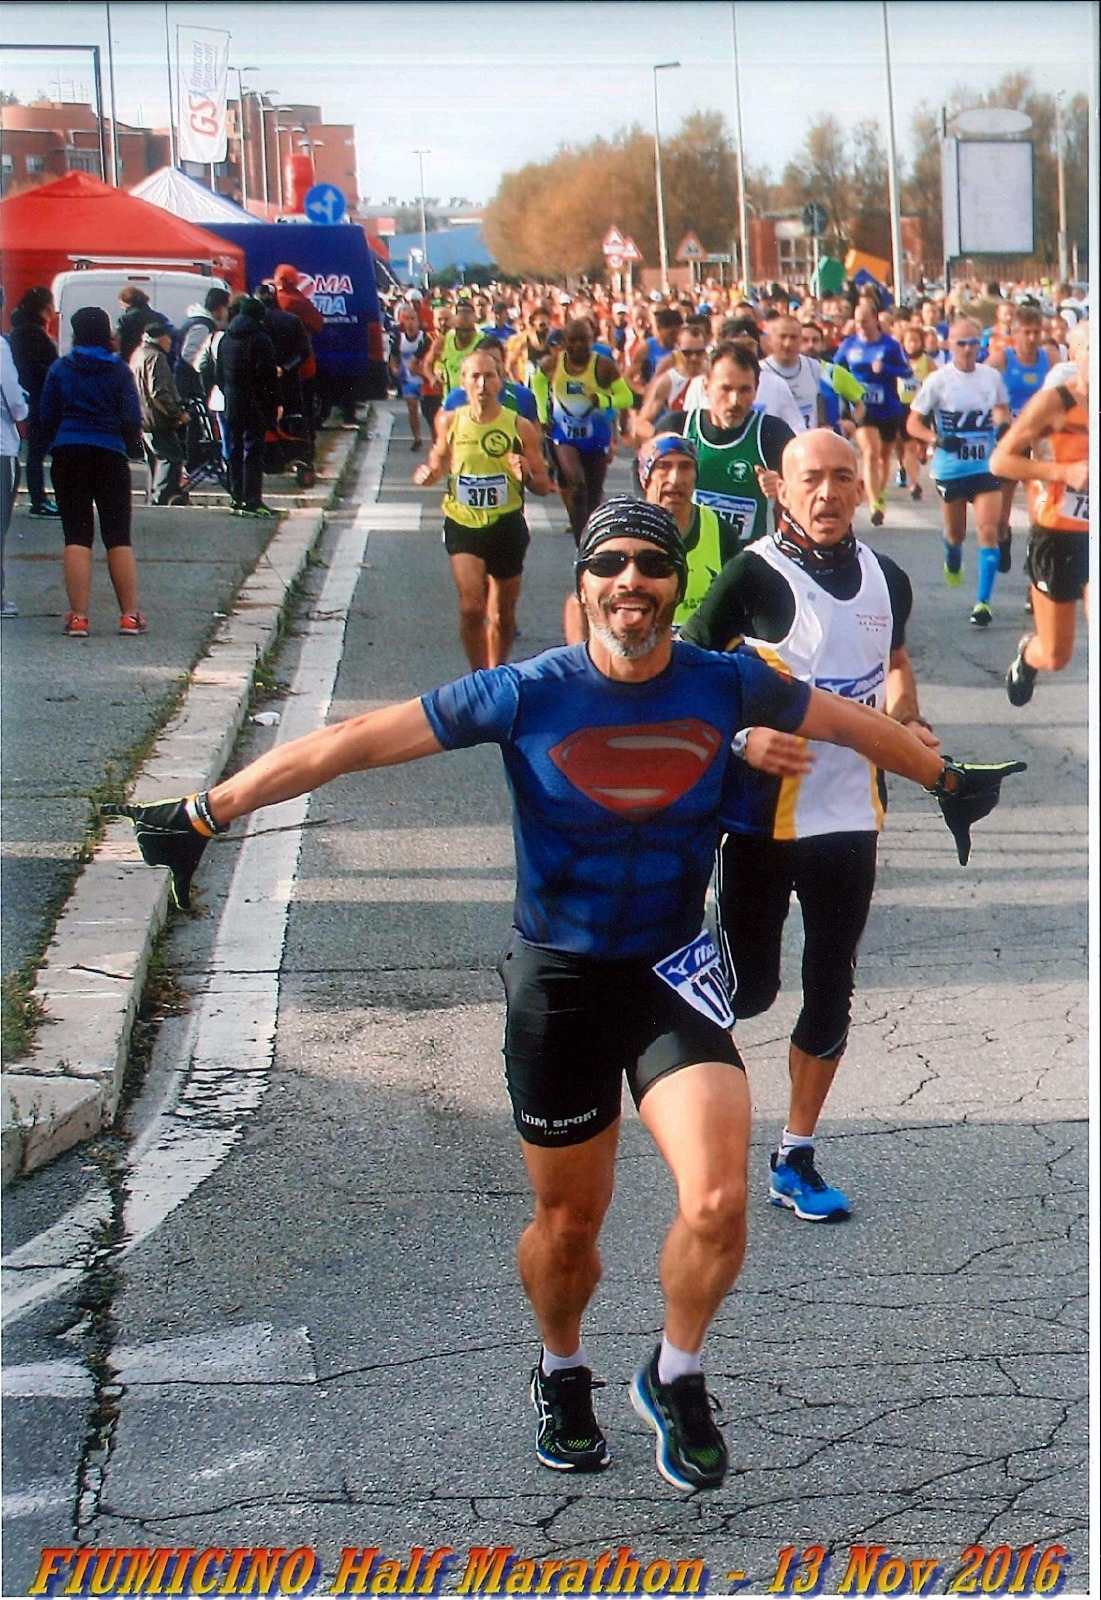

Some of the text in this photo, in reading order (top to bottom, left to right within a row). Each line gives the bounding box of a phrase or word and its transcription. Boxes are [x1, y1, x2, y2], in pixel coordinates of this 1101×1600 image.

[188, 95, 218, 138] GS
[468, 487, 498, 507] 376
[553, 1107, 598, 1127] SPORT
